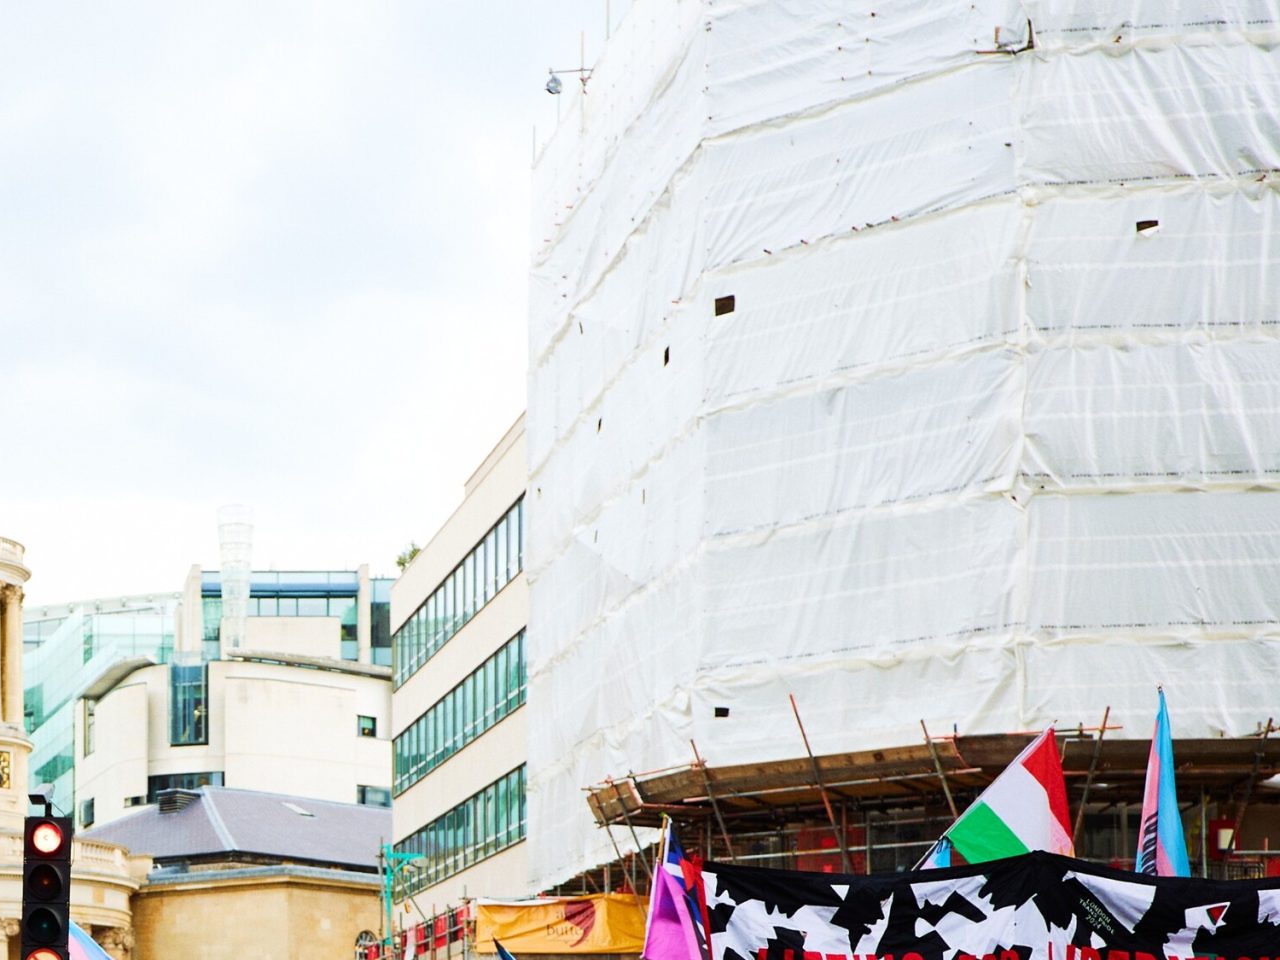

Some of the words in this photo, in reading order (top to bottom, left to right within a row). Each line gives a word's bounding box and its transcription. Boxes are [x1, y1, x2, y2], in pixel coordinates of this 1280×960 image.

[1079, 897, 1098, 918] TRANS
[1098, 917, 1115, 935] PRIDE
[1086, 898, 1111, 923] LONDON
